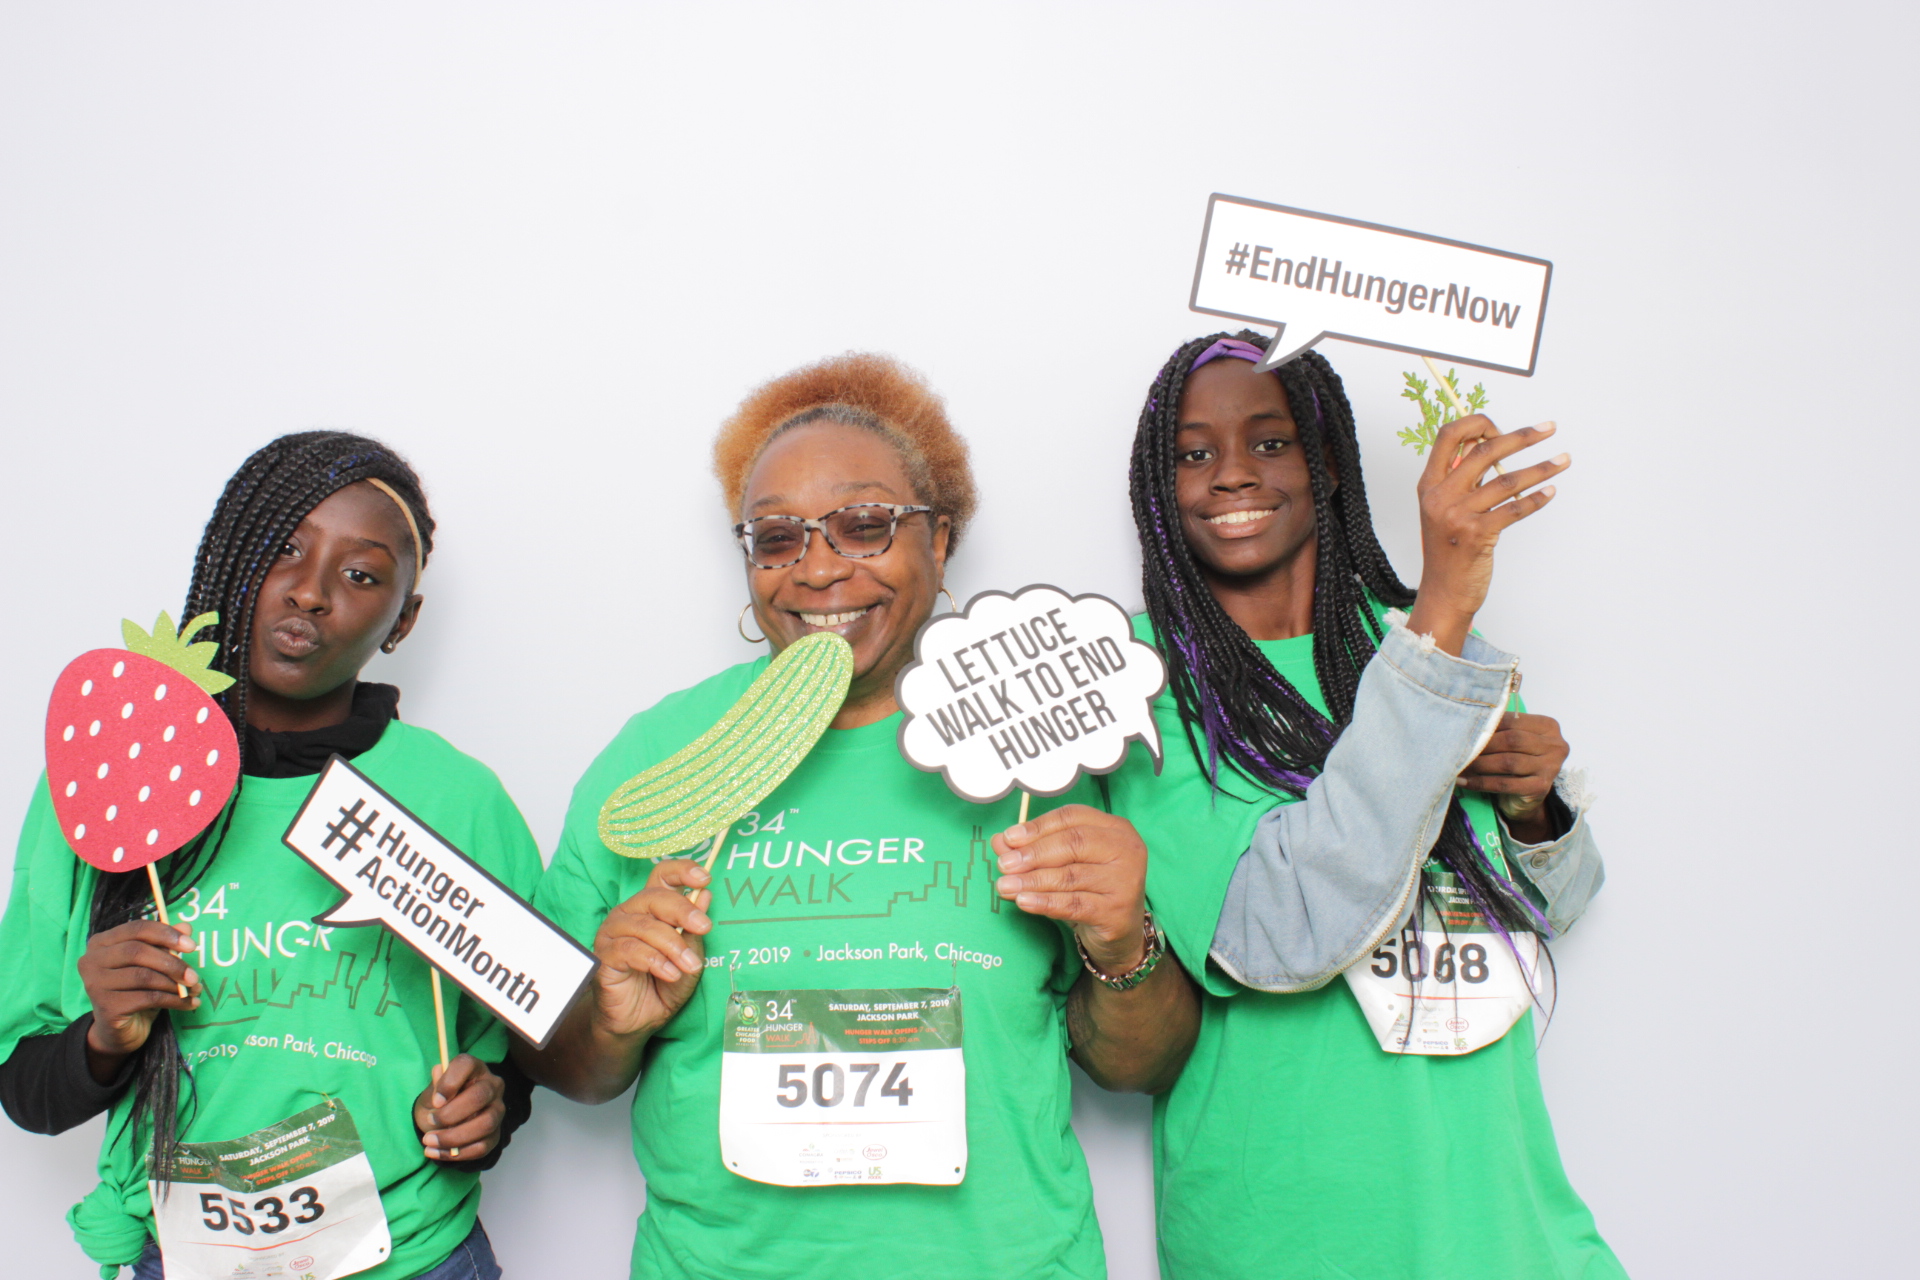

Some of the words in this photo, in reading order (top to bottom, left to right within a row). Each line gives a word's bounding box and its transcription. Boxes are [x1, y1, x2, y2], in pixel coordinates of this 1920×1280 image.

[1225, 242, 1521, 329] #EndHungerNow
[936, 608, 1077, 693] LETTUCE
[925, 679, 1024, 747] WALK
[1015, 662, 1064, 705] TO
[1059, 636, 1127, 689] END
[988, 690, 1117, 770] HUNGER
[726, 838, 925, 869] HUNGER
[724, 872, 855, 908] WALK
[355, 855, 540, 1014] ActionMonth
[747, 946, 791, 965] 2019
[816, 945, 883, 962] Jackson
[888, 941, 928, 962] Park,
[934, 943, 1003, 970] Chicago
[1371, 938, 1489, 984] 5068
[828, 1002, 871, 1012] SATURDAY,
[873, 1001, 919, 1011] SEPTEMBER
[920, 1001, 928, 1010] 7,
[930, 999, 950, 1008] 2019
[857, 1013, 895, 1021] JACKSON
[896, 1011, 919, 1020] PARK
[766, 1023, 803, 1032] HUNGER
[766, 1034, 791, 1042] WALK
[197, 1044, 238, 1064] 2019
[282, 1033, 319, 1058] Park,
[323, 1042, 377, 1068] Chicago
[777, 1062, 913, 1108] 5074
[219, 1146, 263, 1162] SATURDAY,
[263, 1127, 308, 1150] SEPTEMBER
[317, 1114, 336, 1128] 2019
[249, 1144, 288, 1166] JACKSON
[288, 1136, 310, 1150] PARK
[199, 1186, 325, 1235] 5533
